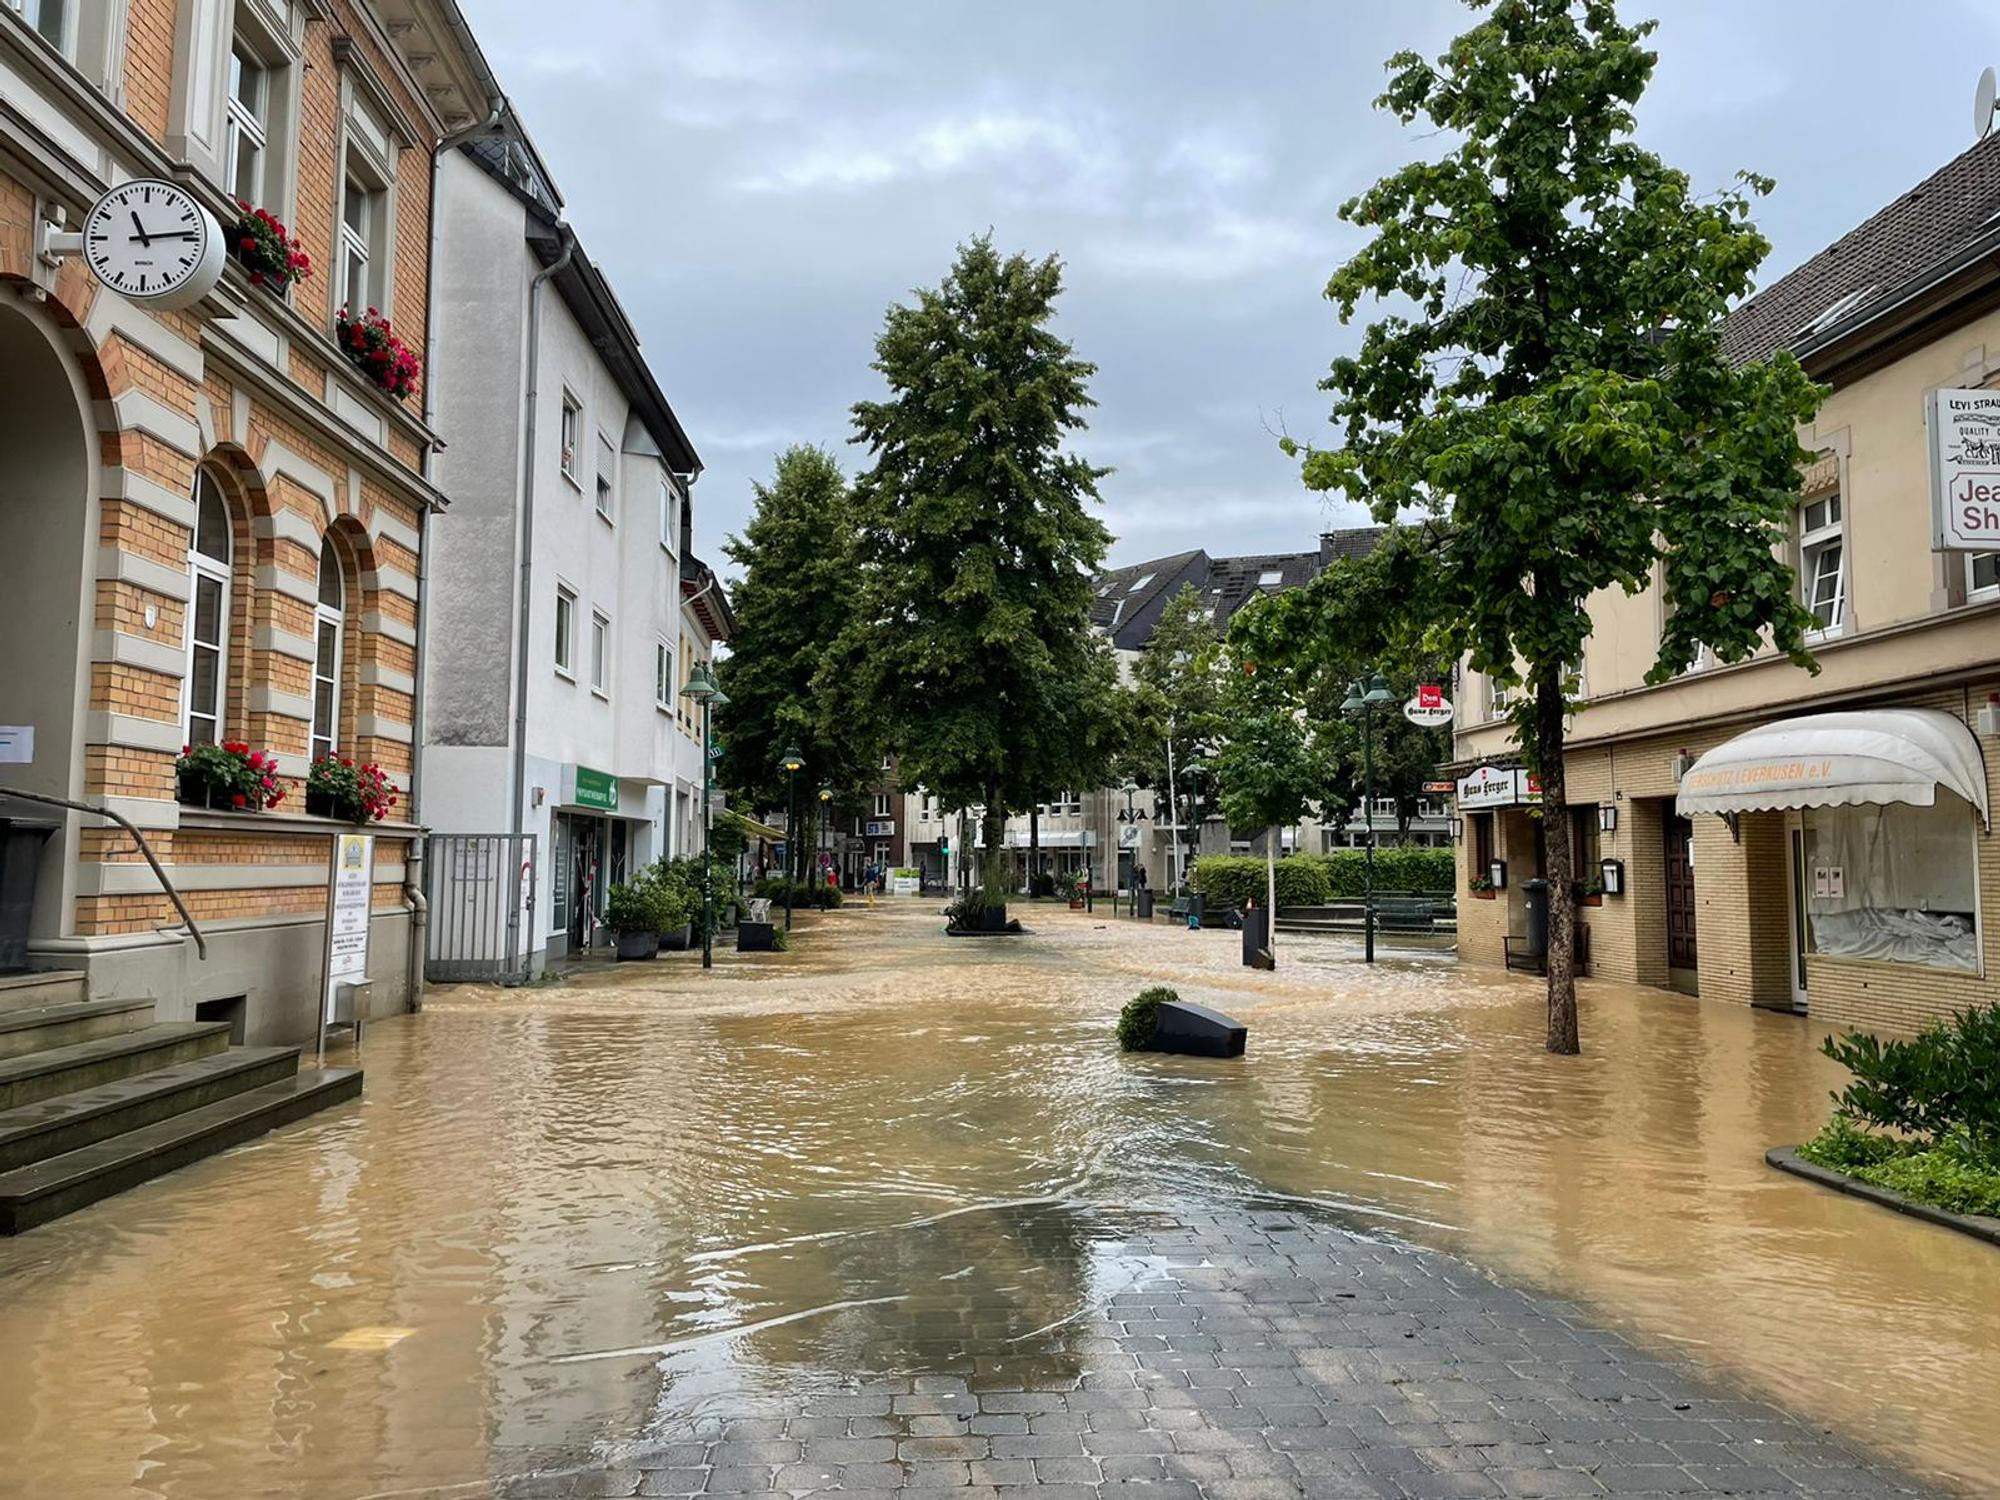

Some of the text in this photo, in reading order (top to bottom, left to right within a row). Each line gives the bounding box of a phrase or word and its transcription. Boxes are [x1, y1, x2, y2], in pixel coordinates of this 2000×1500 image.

[1949, 399, 1971, 410] LEVI
[1959, 426, 1989, 436] QUALITY
[1958, 479, 2000, 502] Jea
[1963, 506, 1999, 530] Sh
[1737, 763, 1804, 784] LEVERKUSEN
